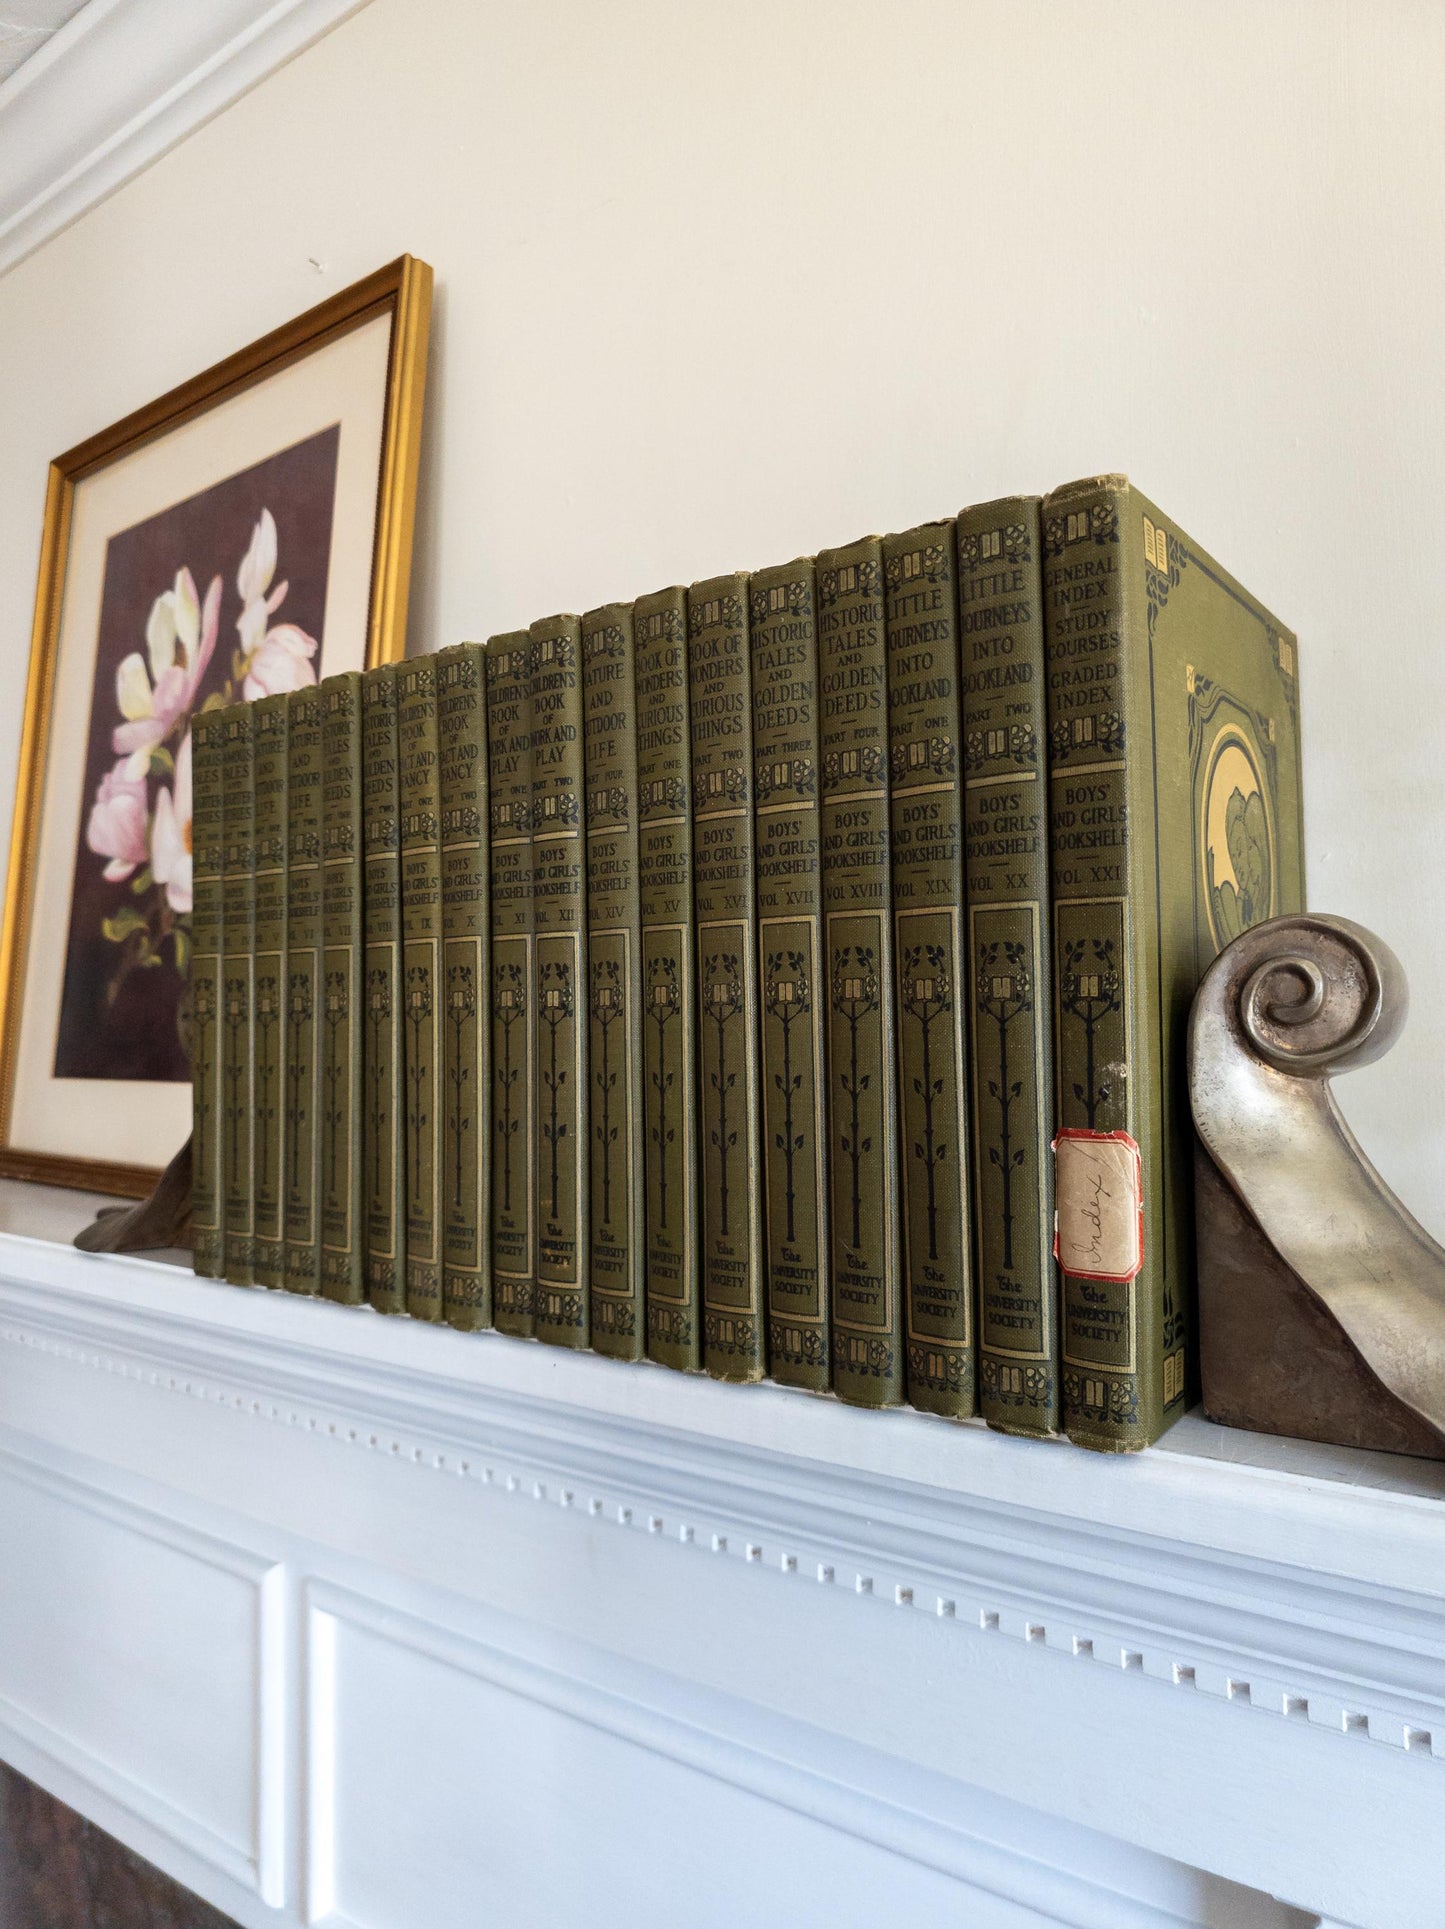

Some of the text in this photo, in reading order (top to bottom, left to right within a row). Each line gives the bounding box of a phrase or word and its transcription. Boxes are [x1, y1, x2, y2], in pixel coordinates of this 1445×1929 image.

[1046, 556, 1117, 588] GENERAL
[962, 570, 1025, 604] LITTLE
[1054, 581, 1108, 606] INDEX
[887, 589, 943, 623] LITTLE
[820, 602, 883, 634] HISTORIC
[1056, 609, 1112, 636] STUDY
[751, 621, 813, 650] HISTORIC
[826, 628, 877, 656] TALES
[888, 619, 950, 650] OURNEYS
[689, 634, 743, 663] BOOK OF
[972, 636, 1014, 661] INTO
[1050, 632, 1120, 660] COURSES
[636, 647, 681, 675] BOOK OF
[756, 645, 807, 671] TALES
[838, 653, 862, 667] AND
[897, 653, 933, 676] INTO
[768, 669, 792, 683] AND
[823, 664, 885, 694] GOLDEN
[963, 662, 1032, 694] BOOKLAND
[1051, 663, 1117, 689] GRADED
[703, 681, 725, 695] AND
[755, 681, 813, 709] GOLDEN
[535, 694, 565, 714] BOOK
[590, 690, 613, 710] AND
[649, 693, 666, 706] AND
[825, 690, 882, 718] DEEDS
[1056, 686, 1113, 710] INDEX
[491, 705, 519, 723] BOOK
[542, 714, 553, 725] OF
[758, 705, 810, 732] DEEDS
[965, 702, 1031, 724] PART TWO
[443, 714, 469, 735] BOOK
[499, 725, 510, 736] OF
[554, 725, 576, 743] AND
[692, 715, 743, 742] THINGS
[890, 716, 948, 738] PART ONE
[509, 736, 529, 752] AND
[638, 725, 683, 749] THINGS
[824, 727, 880, 746] PART FOUR
[417, 751, 435, 766] AND
[458, 744, 478, 760] AND
[535, 745, 566, 767] PLAY
[587, 740, 617, 762] LIFE
[722, 750, 744, 762] TWO
[756, 740, 812, 758] PART THREE
[441, 763, 473, 784] FANCY
[491, 756, 520, 776] PLAY
[663, 759, 681, 770] ONE
[554, 776, 573, 787] TWO
[979, 793, 1022, 815] BOYS'
[1066, 784, 1110, 805] BOYS'
[835, 810, 872, 829] BOYS'
[903, 803, 941, 823] BOYS'
[703, 827, 735, 845] BOYS'
[768, 821, 802, 838] BOYS'
[967, 820, 989, 837] AND
[825, 835, 843, 850] AND
[967, 837, 1040, 858] BOOKSHELF
[1053, 829, 1128, 851] BOOKSHELF
[758, 844, 775, 858] AND
[824, 851, 887, 870] BOOKSHELF
[893, 844, 959, 866] BOOKSHELF
[758, 859, 817, 879] BOOKSHELF
[1055, 866, 1121, 885] VOL XXI
[640, 870, 688, 888] BOOKSHELF
[895, 879, 952, 897] VOL XIX
[970, 874, 1029, 892] VOL XX
[760, 890, 814, 907] VOL XVII
[826, 883, 883, 900] VOL XVIII
[663, 900, 681, 913] XV
[724, 895, 747, 910] XVI
[467, 915, 476, 927] X
[515, 912, 526, 924] XI
[559, 909, 575, 921] XII
[605, 906, 625, 919] XIV
[1072, 1174, 1111, 1264] Index
[716, 1240, 735, 1255] The
[781, 1247, 803, 1263] The
[846, 1253, 869, 1270] The
[710, 1275, 745, 1288] SOCIETY
[837, 1272, 882, 1289] UNIVERSITY
[923, 1266, 945, 1282] The
[775, 1280, 813, 1296] SOCIETY
[914, 1285, 962, 1301] UNIVERSITY
[996, 1275, 1022, 1293] The
[839, 1288, 879, 1305] SOCIETY
[986, 1294, 1039, 1313] UNIVERSITY
[1080, 1285, 1107, 1304] The
[917, 1301, 957, 1318] SOCIETY
[1066, 1304, 1126, 1325] UNIVERSITY
[988, 1313, 1034, 1330] SOCIETY
[1072, 1324, 1122, 1343] SOCIETY
